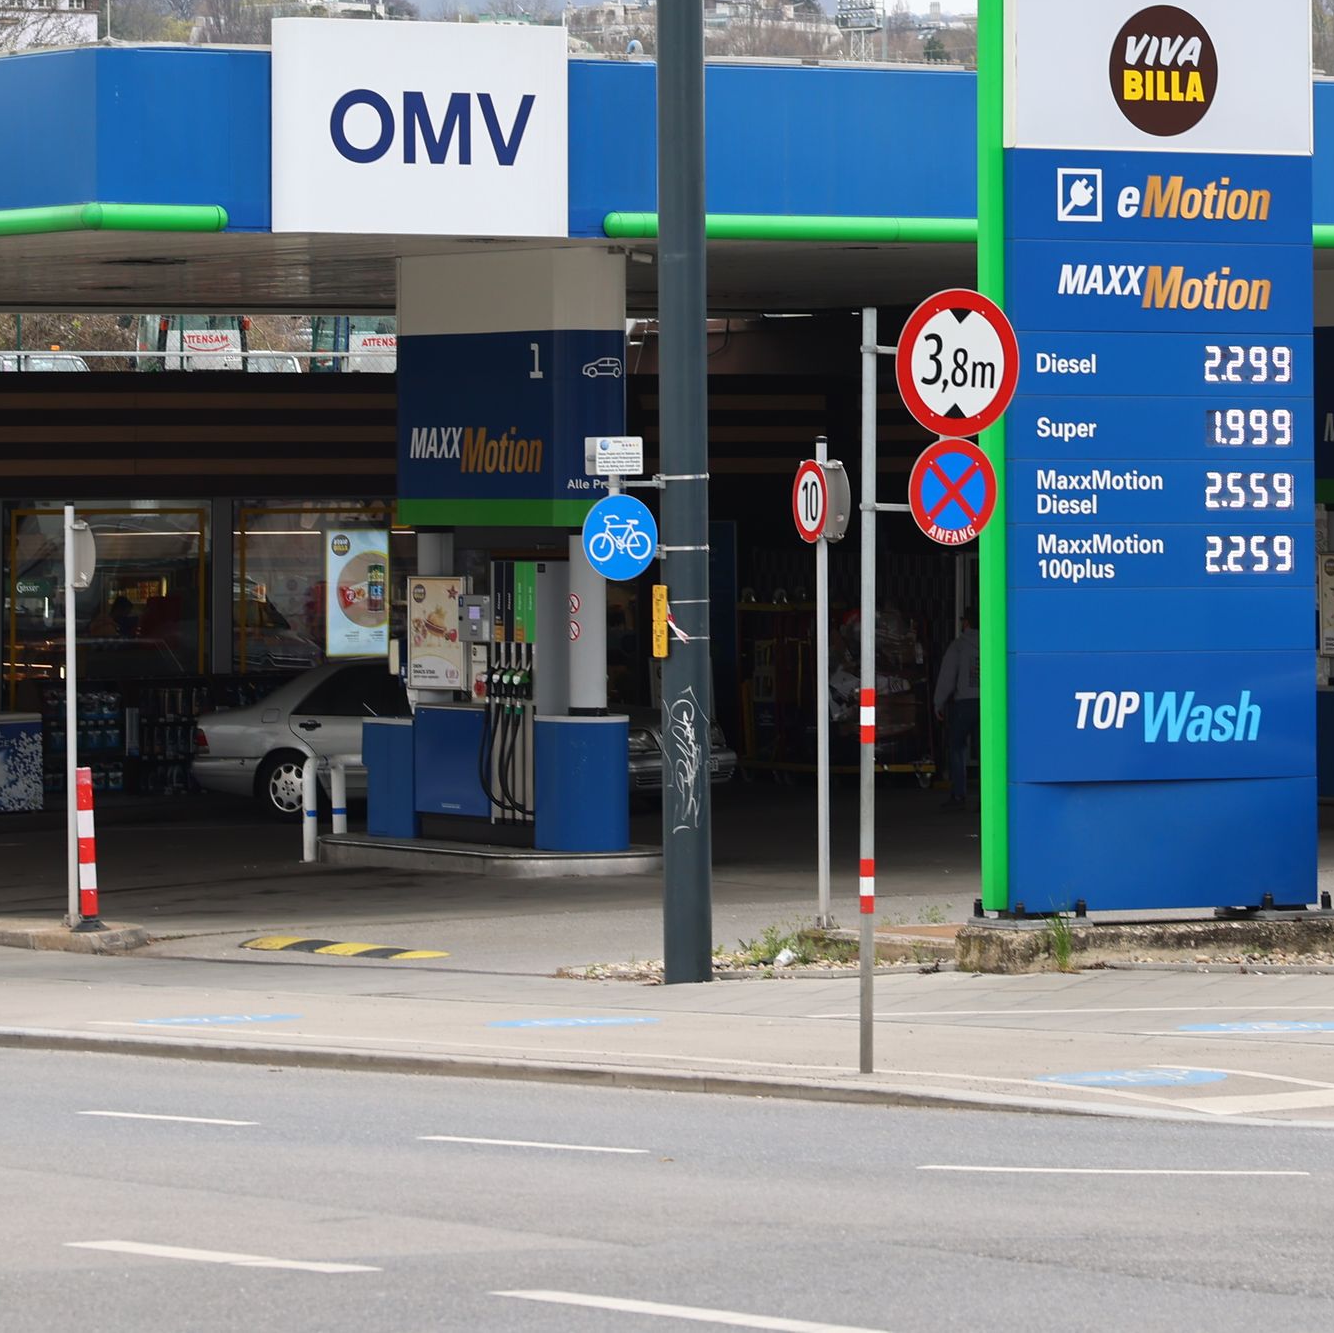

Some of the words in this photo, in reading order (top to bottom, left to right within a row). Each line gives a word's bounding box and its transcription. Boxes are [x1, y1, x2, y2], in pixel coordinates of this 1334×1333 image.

[1125, 33, 1202, 67] VIVA
[1123, 69, 1205, 102] BILLA
[330, 88, 536, 166] OMV
[1117, 175, 1271, 220] eMotion
[362, 337, 396, 347] ATTENS
[530, 343, 543, 378] 1
[921, 332, 995, 393] 3,8m
[1036, 352, 1097, 374] Diesel
[1204, 345, 1292, 382] 2.299
[1036, 416, 1097, 443] Super
[1214, 409, 1292, 445] 1.999
[567, 478, 590, 490] Alle
[802, 480, 818, 522] 10
[1036, 470, 1164, 490] MaxxMotion
[1205, 472, 1293, 508] 2.559
[1037, 493, 1098, 515] Diesel
[928, 524, 977, 544] ANFANG
[1037, 533, 1164, 554] MaxxMotion
[1205, 535, 1293, 573] 2.259
[1038, 559, 1115, 583] 100plus
